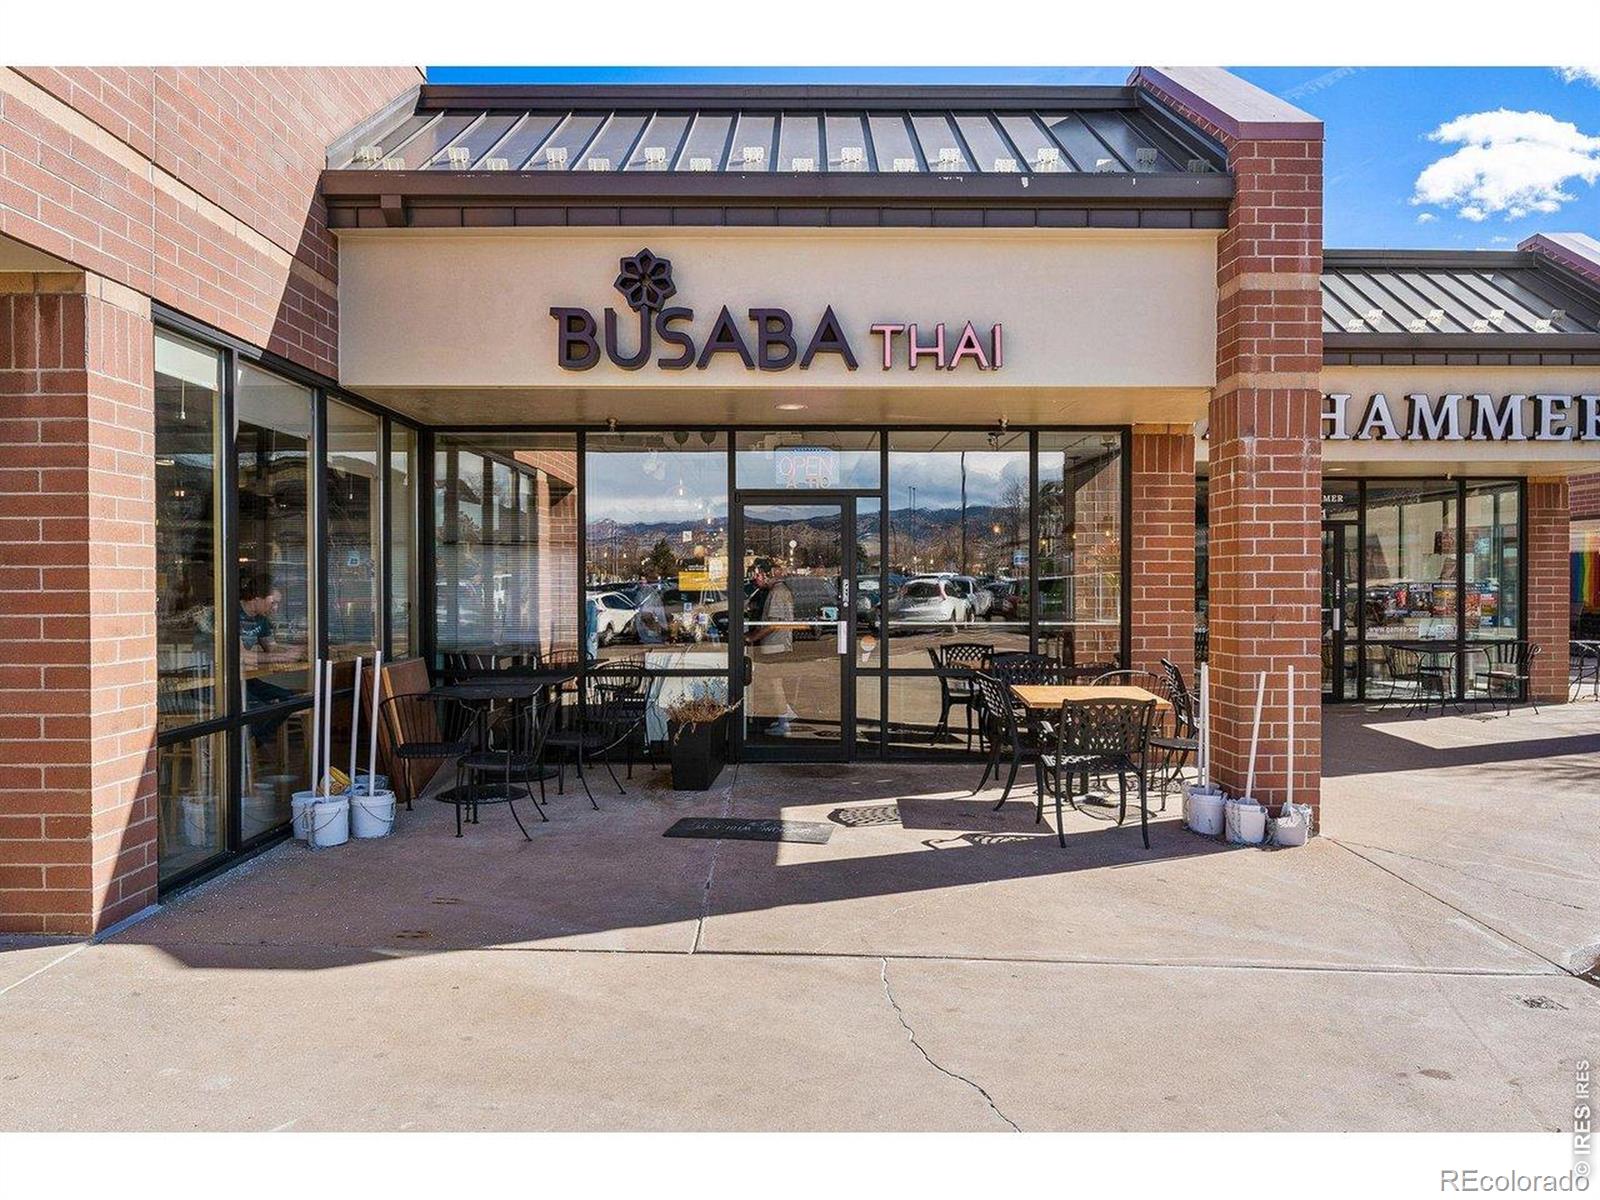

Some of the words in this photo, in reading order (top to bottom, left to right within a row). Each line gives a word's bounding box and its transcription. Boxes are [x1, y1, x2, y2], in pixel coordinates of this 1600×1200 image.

[549, 304, 858, 372] BUSABA
[870, 320, 1004, 371] THAI
[779, 455, 833, 477] OPEN
